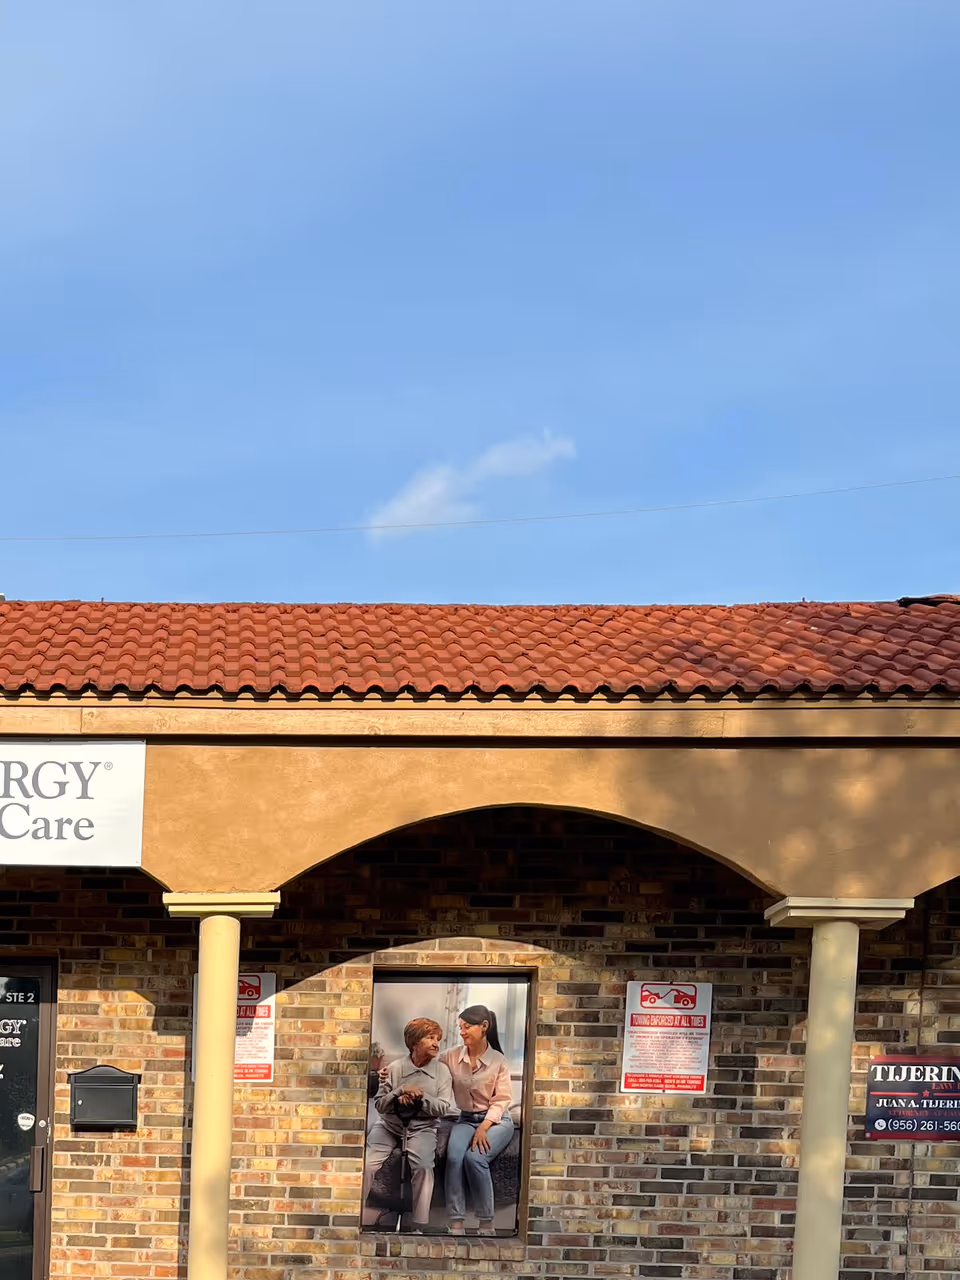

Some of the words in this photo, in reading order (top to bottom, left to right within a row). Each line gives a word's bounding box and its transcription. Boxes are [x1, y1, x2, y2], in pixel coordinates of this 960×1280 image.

[5, 992, 25, 1003] STE
[26, 993, 35, 1003] 2
[246, 1006, 256, 1017] ALL
[632, 1014, 651, 1026] TOWING
[650, 1014, 674, 1027] ENFORCED
[673, 1015, 681, 1027] AT
[681, 1015, 690, 1027] ALL
[690, 1015, 705, 1027] TIMES
[876, 1098, 906, 1108] JUAN
[907, 1099, 920, 1108] A.
[888, 1119, 918, 1131] (956)
